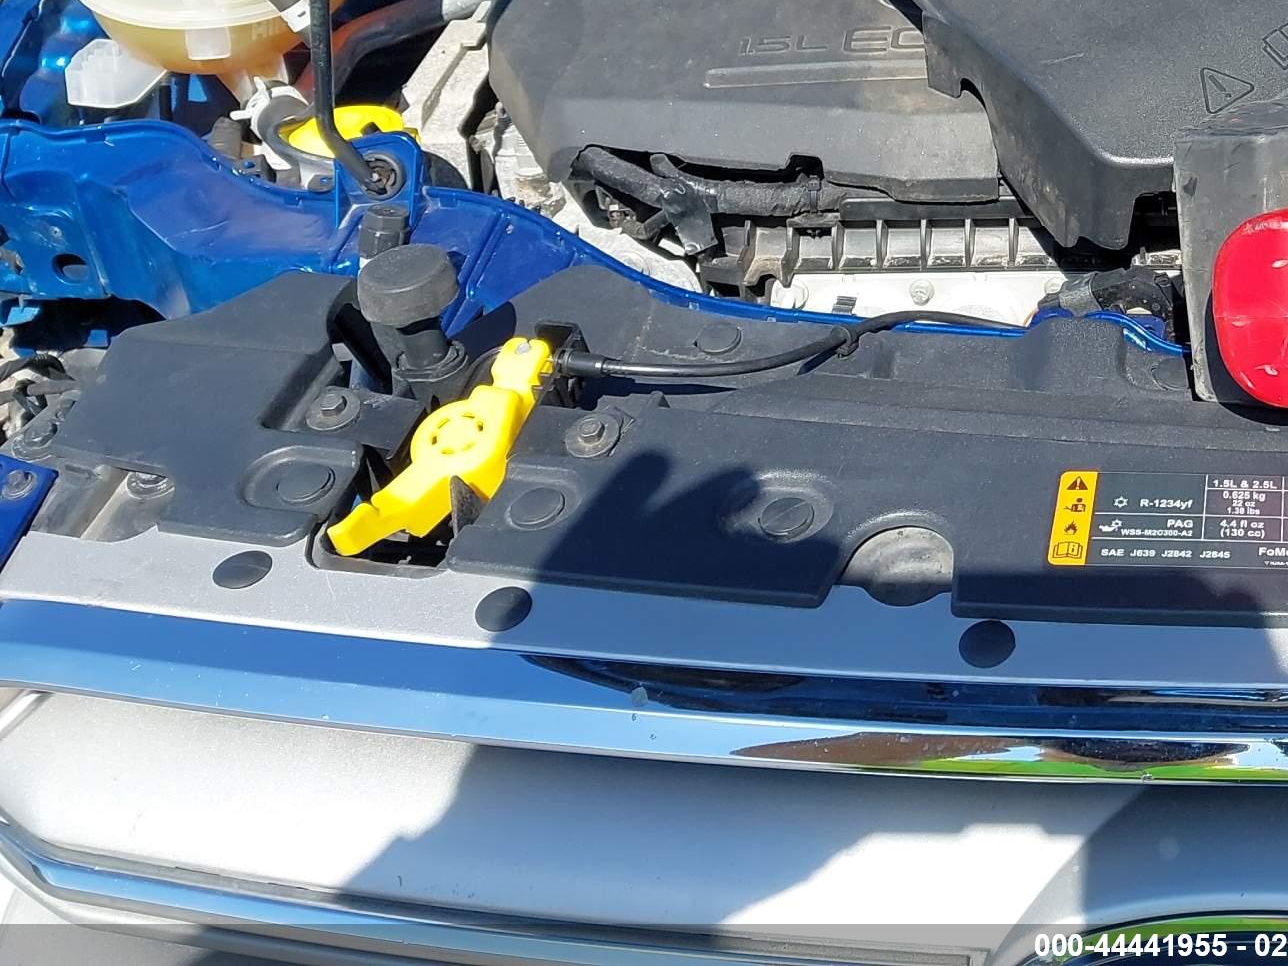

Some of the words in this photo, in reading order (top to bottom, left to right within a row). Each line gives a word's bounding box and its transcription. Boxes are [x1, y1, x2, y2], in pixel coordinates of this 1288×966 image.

[1213, 479, 1237, 488] 1.5L
[1240, 480, 1249, 488] &
[1252, 480, 1278, 489] 2.5L
[1222, 490, 1250, 500] 0.625
[1252, 491, 1266, 502] kg
[1139, 498, 1193, 510] R-1234yf
[1246, 507, 1260, 515] lbs
[1166, 519, 1194, 528] PAG
[1219, 519, 1237, 528] 4.4
[1240, 519, 1248, 528] fl
[1250, 521, 1265, 529] oz
[1220, 528, 1245, 538] (130
[1247, 529, 1265, 539] cc)
[1100, 548, 1125, 557] SAE
[1129, 549, 1156, 558] J639
